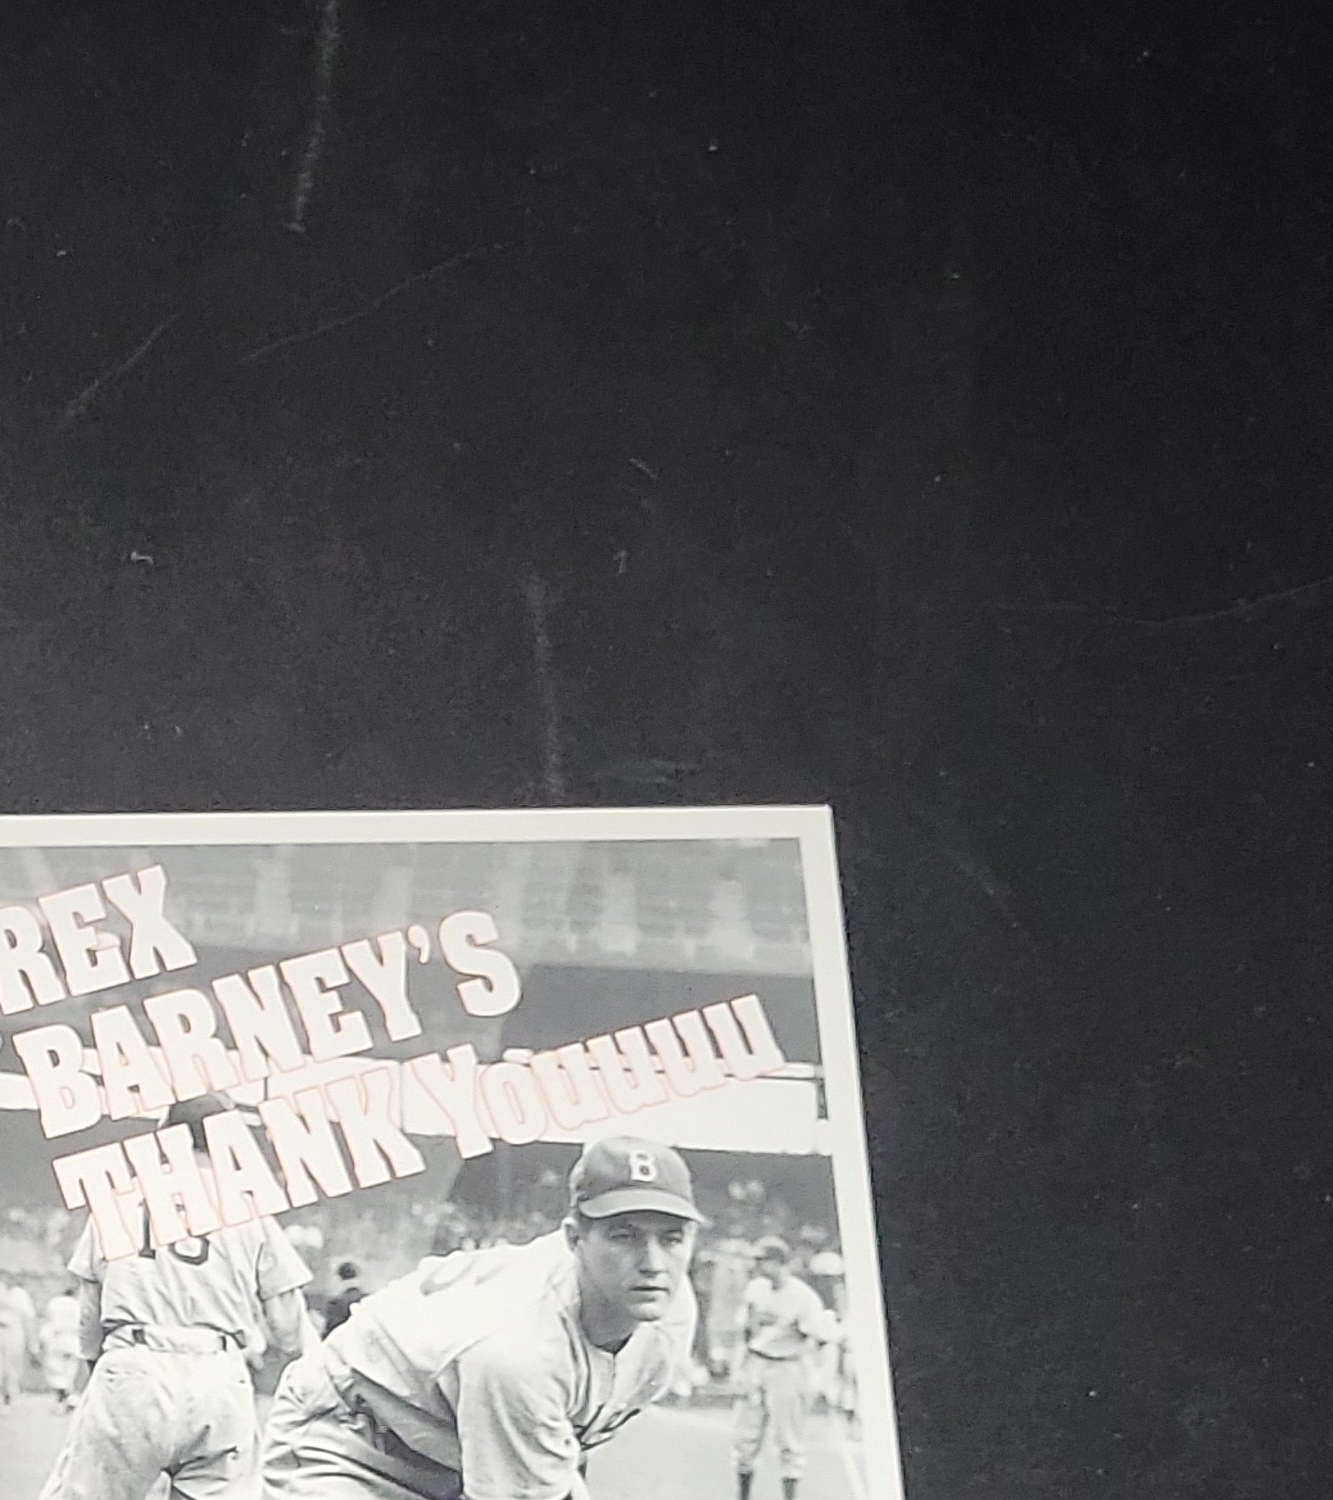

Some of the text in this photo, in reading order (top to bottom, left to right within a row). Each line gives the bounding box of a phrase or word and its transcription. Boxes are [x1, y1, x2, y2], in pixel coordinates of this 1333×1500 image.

[12, 910, 523, 1138] BARNEY'S
[51, 1062, 425, 1263] THANK
[629, 1150, 657, 1182] B
